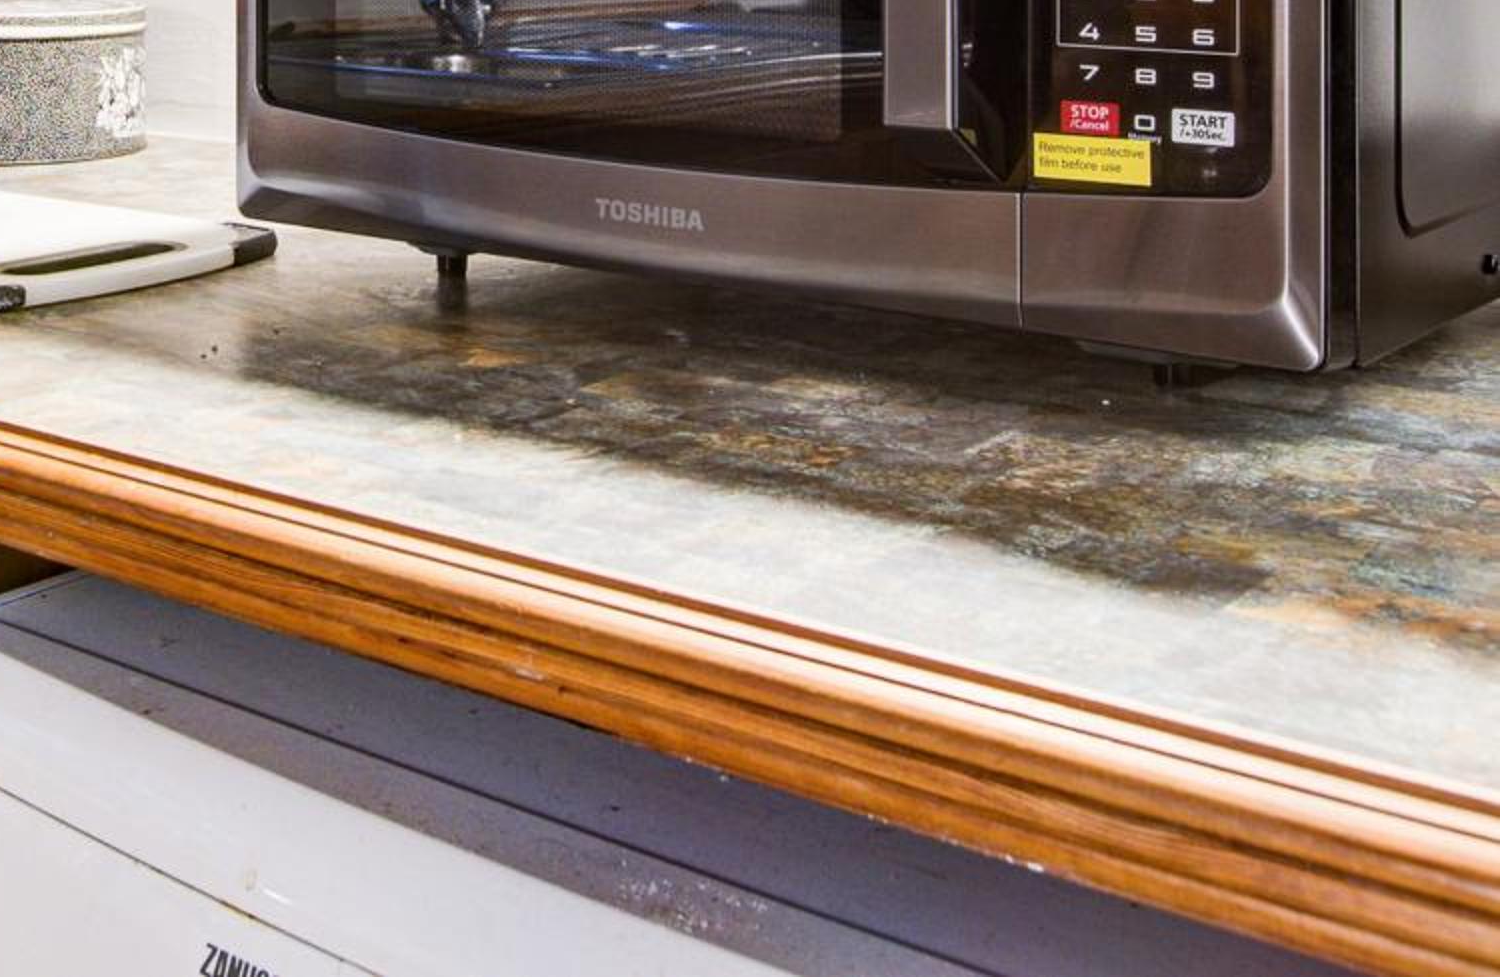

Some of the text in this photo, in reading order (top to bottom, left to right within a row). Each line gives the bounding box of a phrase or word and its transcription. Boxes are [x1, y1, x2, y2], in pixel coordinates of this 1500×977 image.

[1079, 23, 1100, 40] 4
[1135, 26, 1157, 43] 5
[1192, 29, 1215, 46] 6
[1079, 64, 1100, 81] 7
[1135, 68, 1157, 85] 8
[1192, 72, 1215, 89] 9
[1070, 104, 1109, 119] STOP
[1179, 114, 1227, 129] START
[1040, 141, 1145, 160] Remove protective
[1039, 157, 1122, 173] film before use
[595, 197, 705, 232] TOSHIBA
